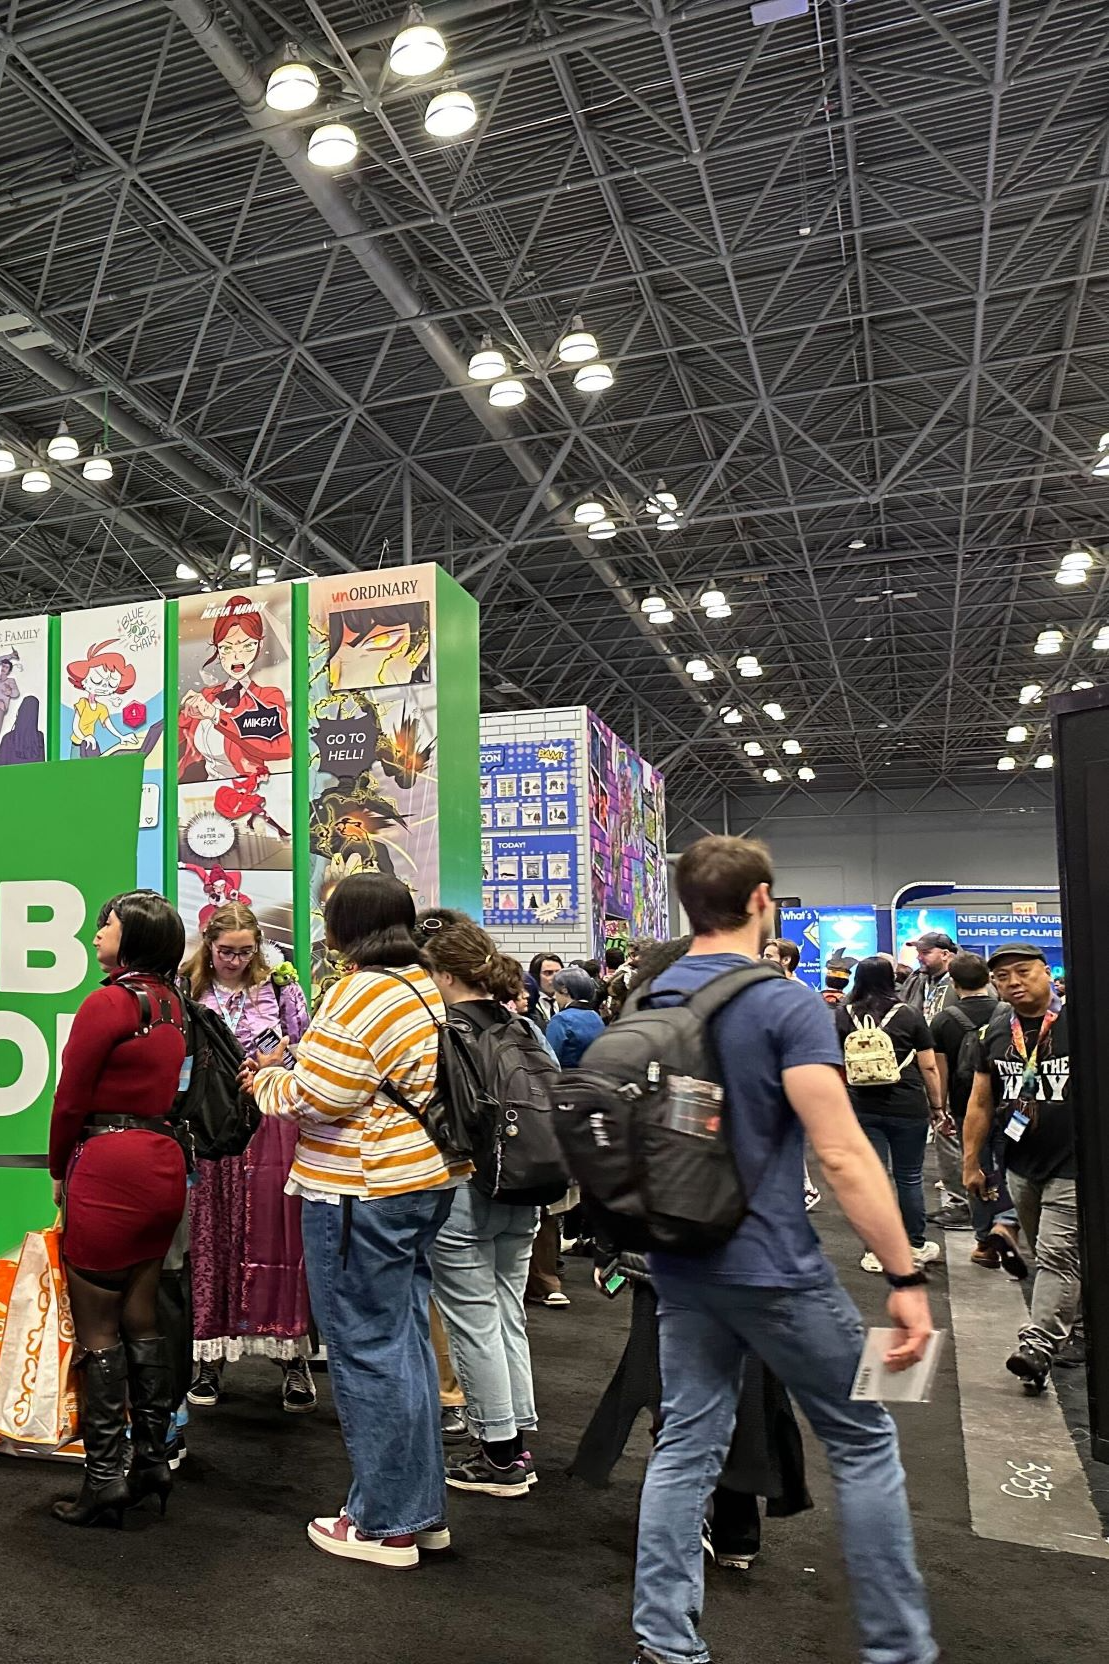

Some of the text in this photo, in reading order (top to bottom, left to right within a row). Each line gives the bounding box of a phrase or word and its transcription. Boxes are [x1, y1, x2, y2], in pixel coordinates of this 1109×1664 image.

[332, 580, 418, 603] unORDINARY
[201, 601, 269, 620] MAFIA NANNY
[121, 606, 144, 629] BLUE
[5, 628, 40, 641] FAMILY
[130, 630, 156, 652] CHAIR
[243, 716, 277, 728] MIKEY!
[326, 732, 366, 745] GO TO
[328, 749, 364, 762] HELL!
[538, 748, 564, 761] BAM!
[497, 841, 526, 849] TODAY!
[781, 910, 811, 920] What's
[957, 915, 1030, 923] NERGIZING
[958, 929, 998, 937] OURS
[1001, 929, 1017, 937] OF
[1020, 929, 1051, 937] CALM
[994, 1059, 1023, 1076] THIS
[1041, 1056, 1069, 1074] THE
